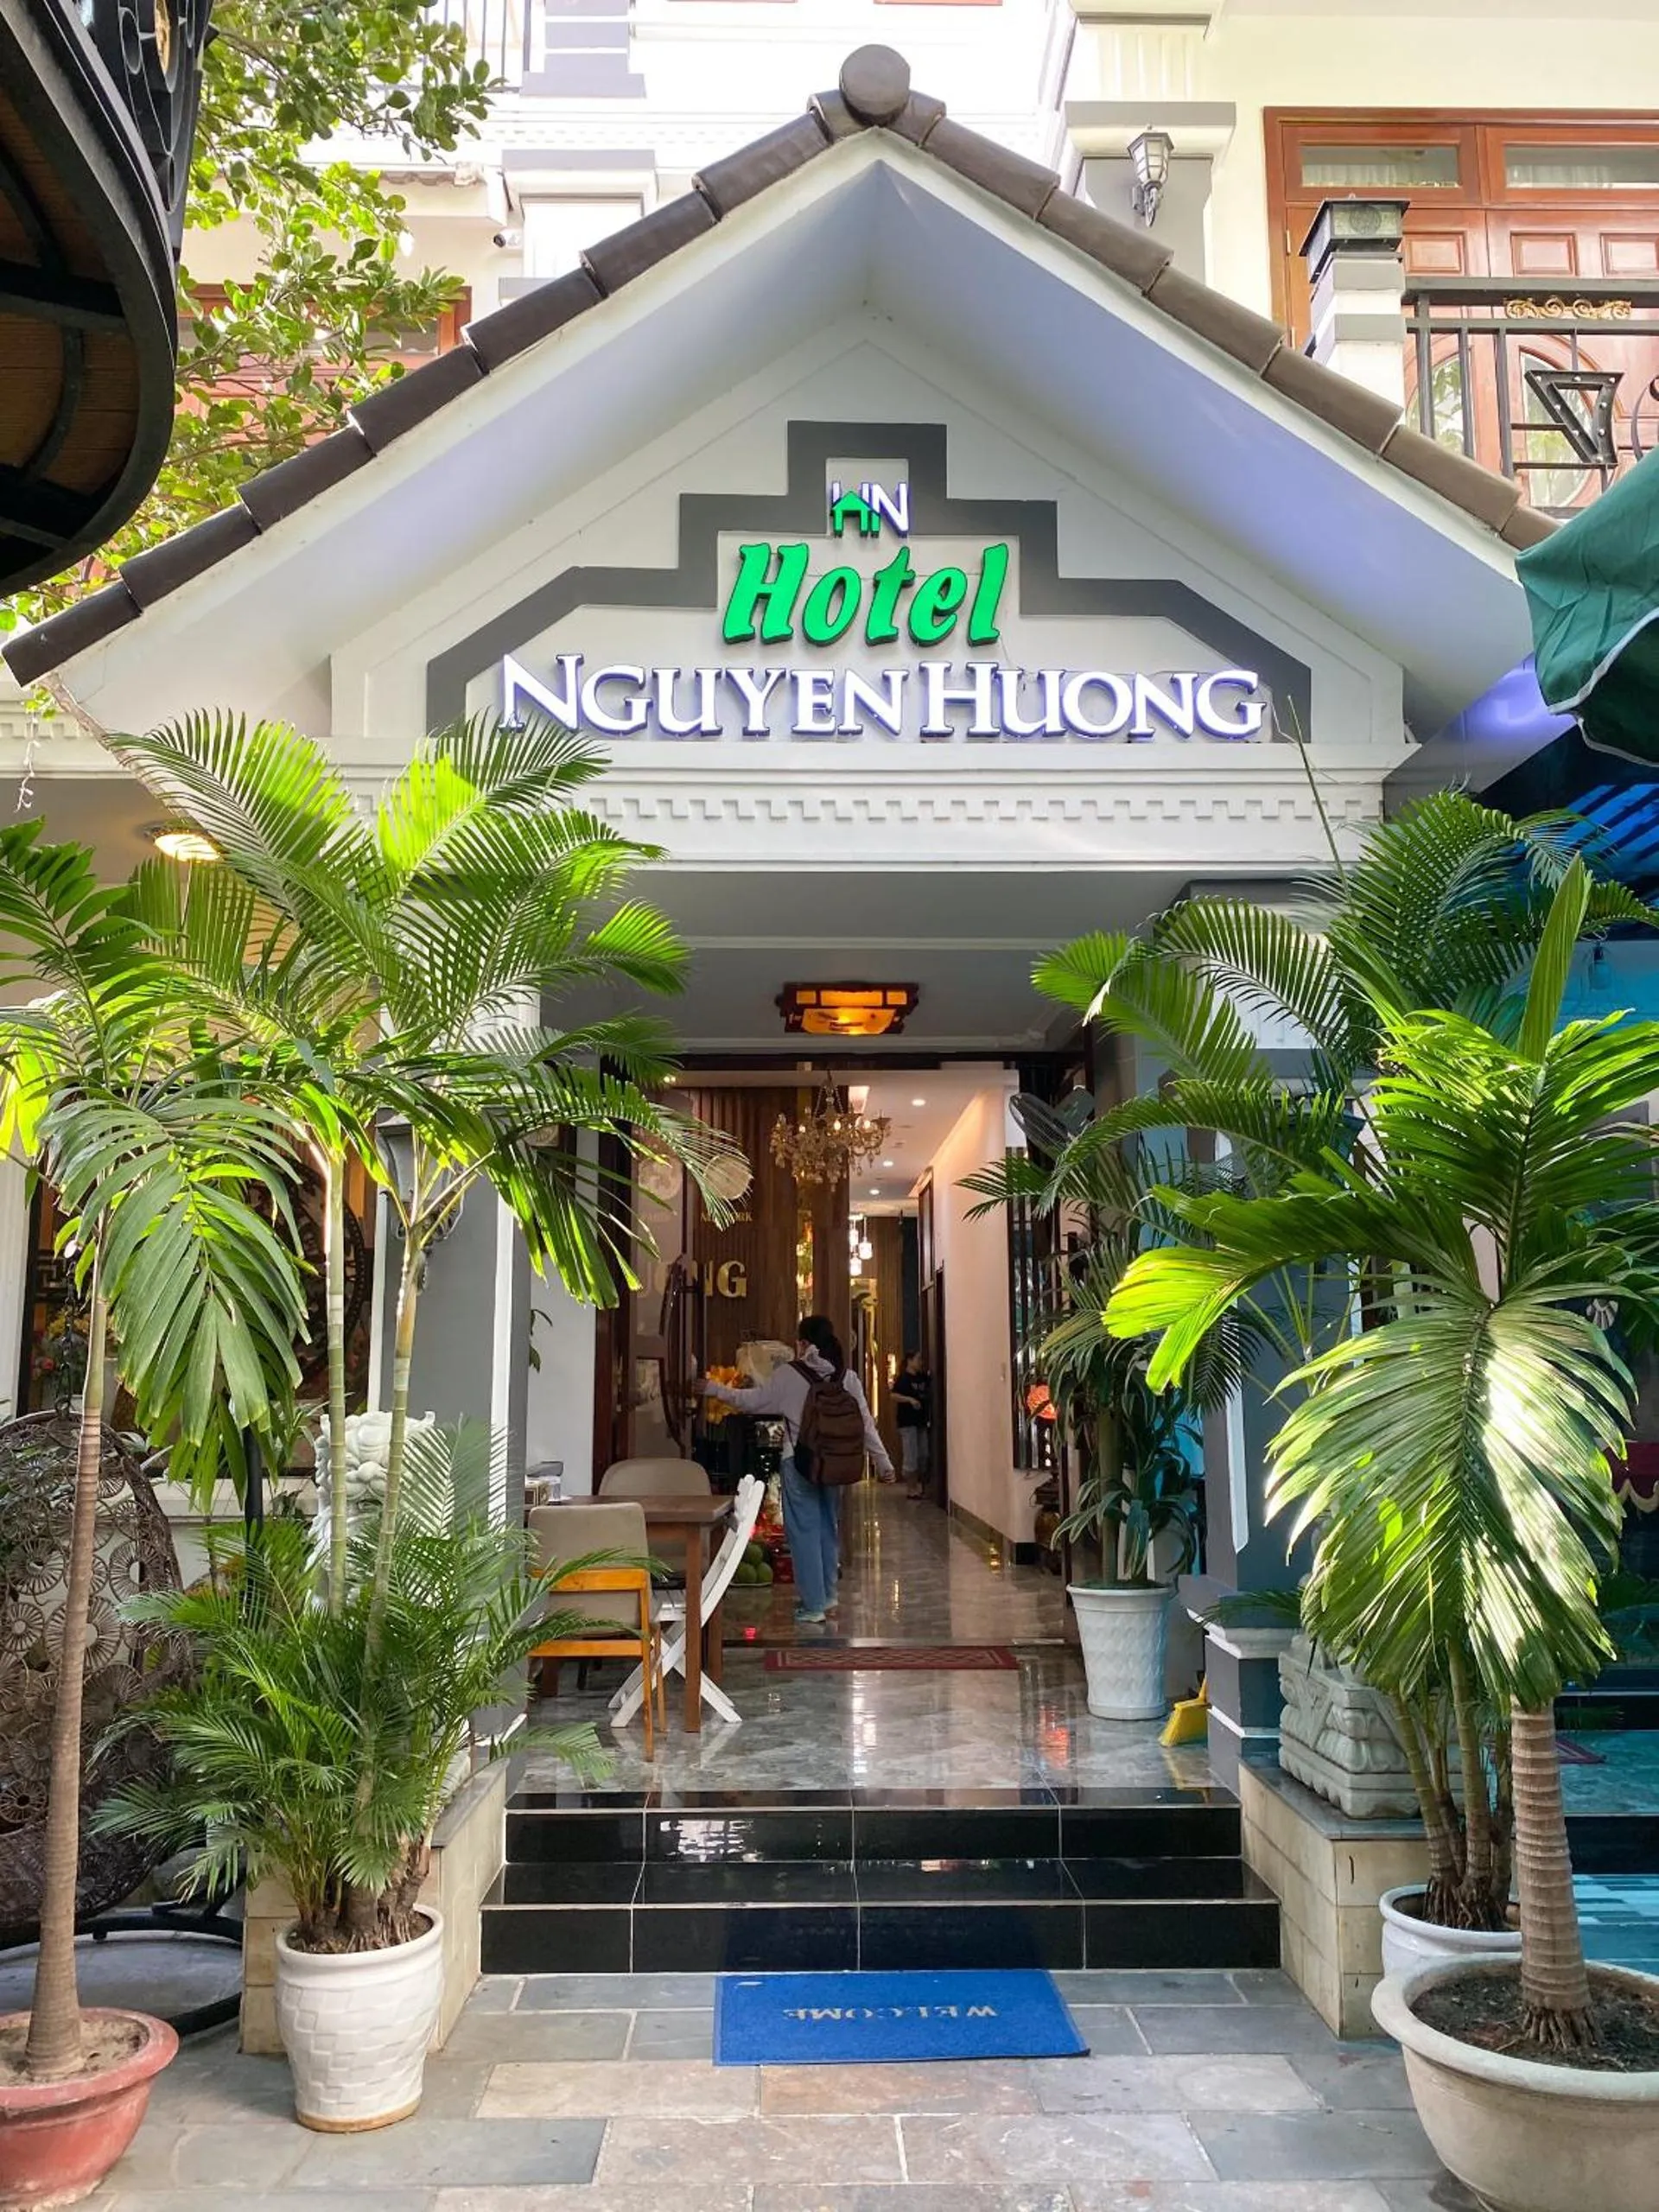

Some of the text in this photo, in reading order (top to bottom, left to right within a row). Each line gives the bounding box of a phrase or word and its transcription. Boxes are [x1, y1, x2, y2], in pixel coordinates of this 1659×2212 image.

[723, 543, 1008, 647] Hotel
[499, 653, 1267, 740] NGUYEN HUONG
[783, 2005, 997, 2020] WELCOME
